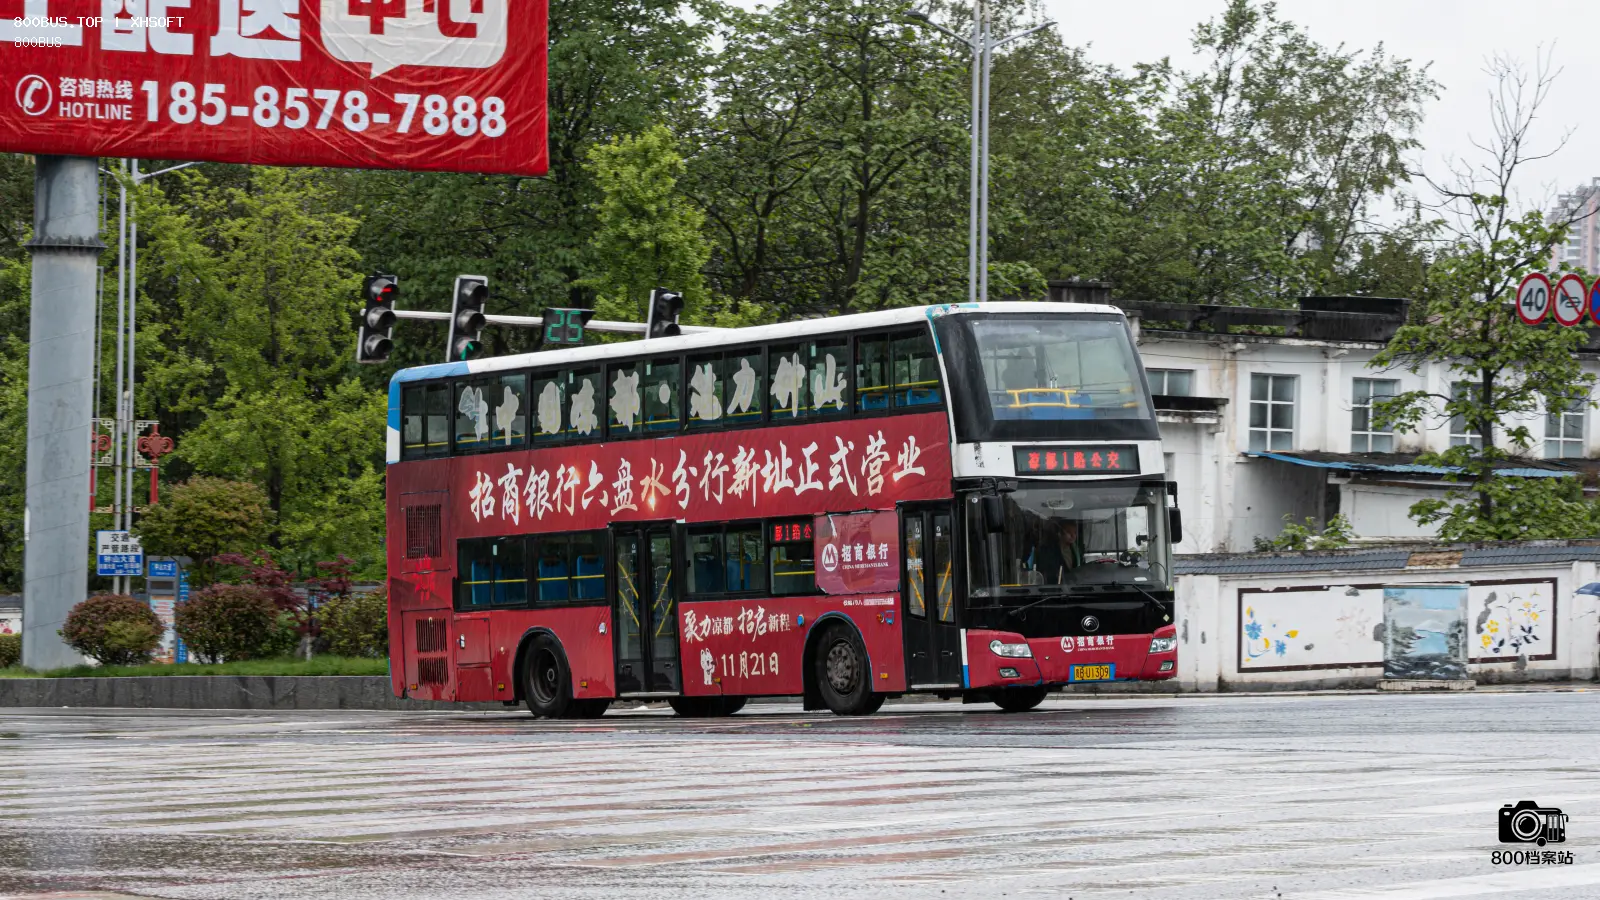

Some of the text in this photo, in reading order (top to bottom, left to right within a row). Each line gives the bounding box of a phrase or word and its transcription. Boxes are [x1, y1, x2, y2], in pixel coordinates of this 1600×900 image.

[59, 77, 133, 100] 咨询热线
[59, 102, 132, 120] HOTLINE
[141, 80, 507, 137] 185-8578-7888
[1522, 288, 1546, 311] 40
[546, 310, 583, 342] 25
[469, 430, 927, 525] 招商银行六盘水分行新址正式营业
[841, 543, 888, 562] 招商银行
[721, 650, 779, 679] 11月21日
